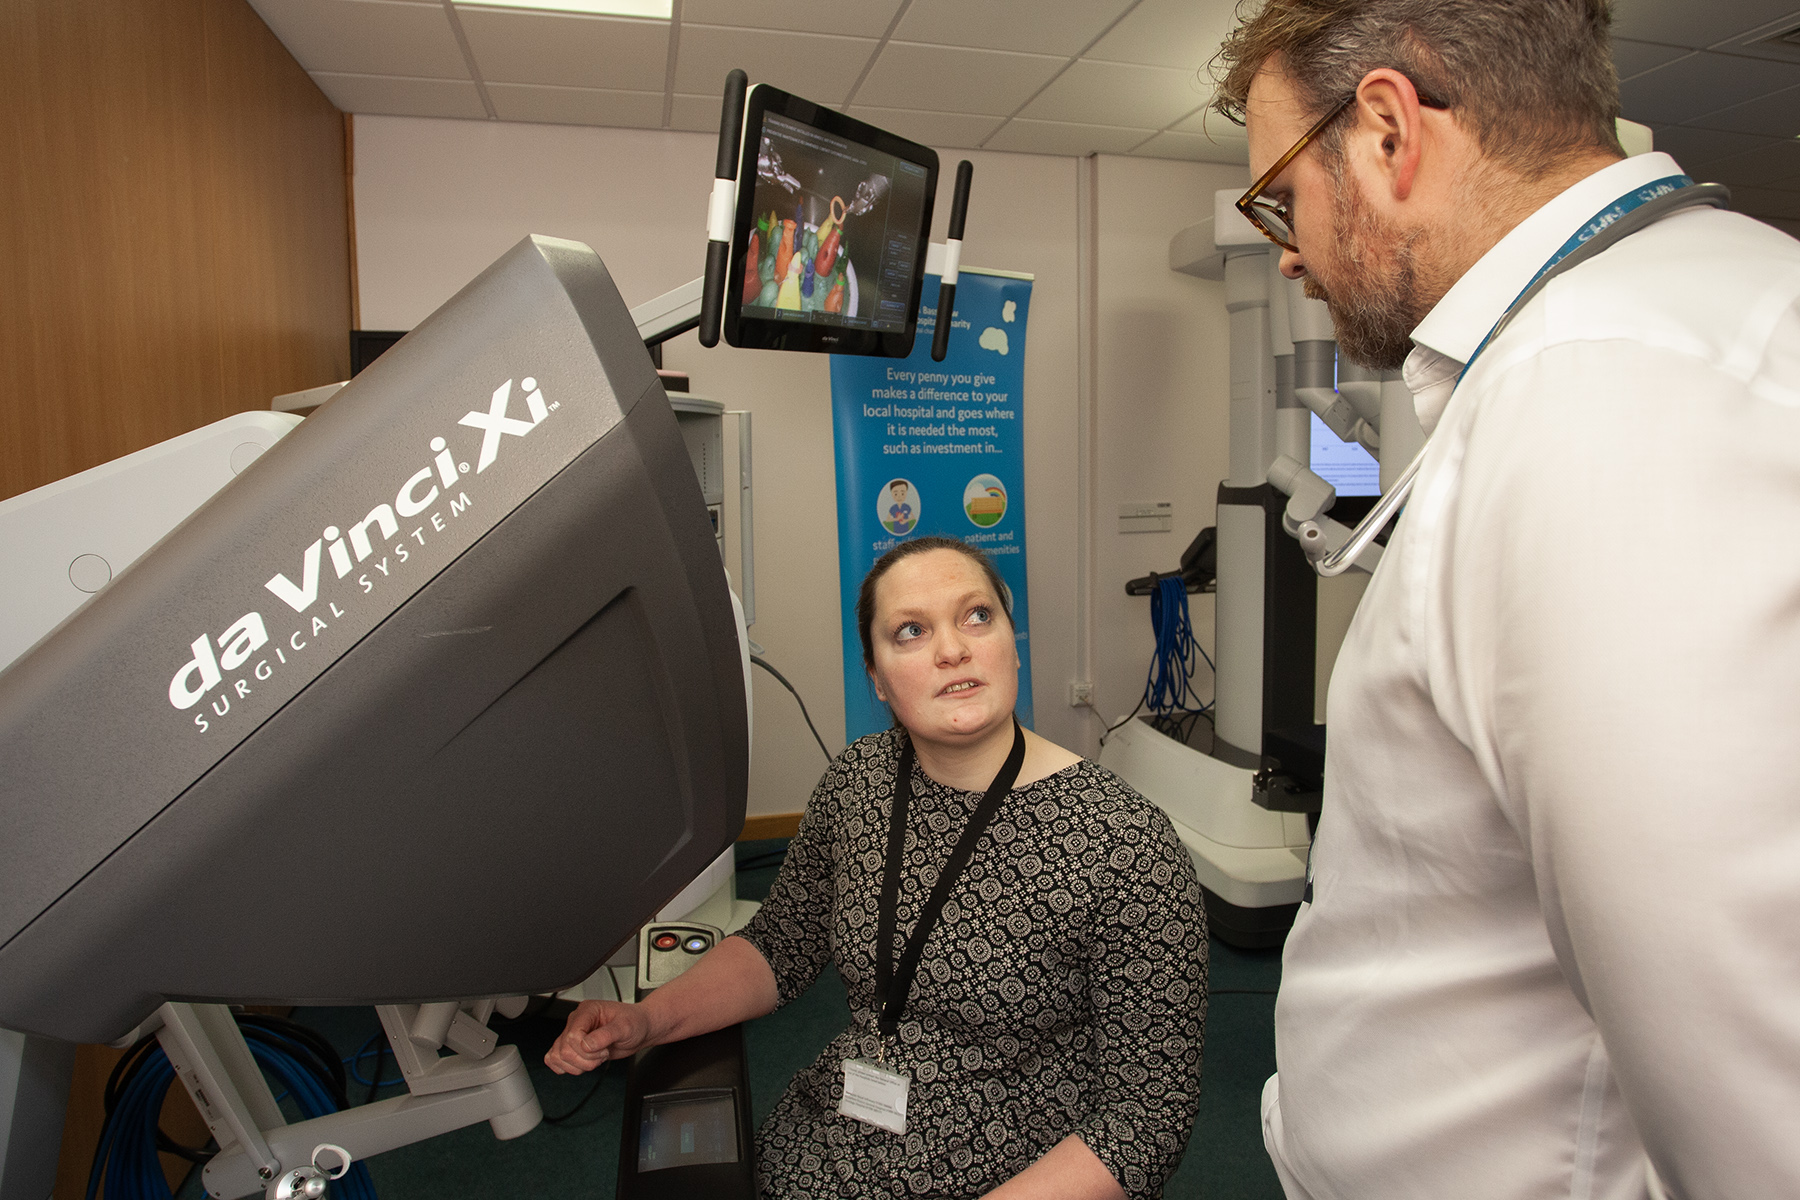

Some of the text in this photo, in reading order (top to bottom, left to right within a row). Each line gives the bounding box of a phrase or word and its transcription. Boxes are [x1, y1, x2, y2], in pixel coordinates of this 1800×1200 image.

[886, 367, 996, 388] Every penny you give
[872, 386, 1008, 405] makes a difference to your
[863, 404, 1015, 422] local hospital and goes where
[887, 423, 998, 438] it is needed the most,
[883, 441, 908, 454] such
[910, 445, 921, 454] as
[923, 441, 982, 455] investment
[872, 537, 895, 551] staff
[964, 530, 1014, 544] patient and
[981, 544, 1020, 555] menities
[194, 491, 473, 733] SURGICAL SYSTEM
[168, 611, 269, 710] da
